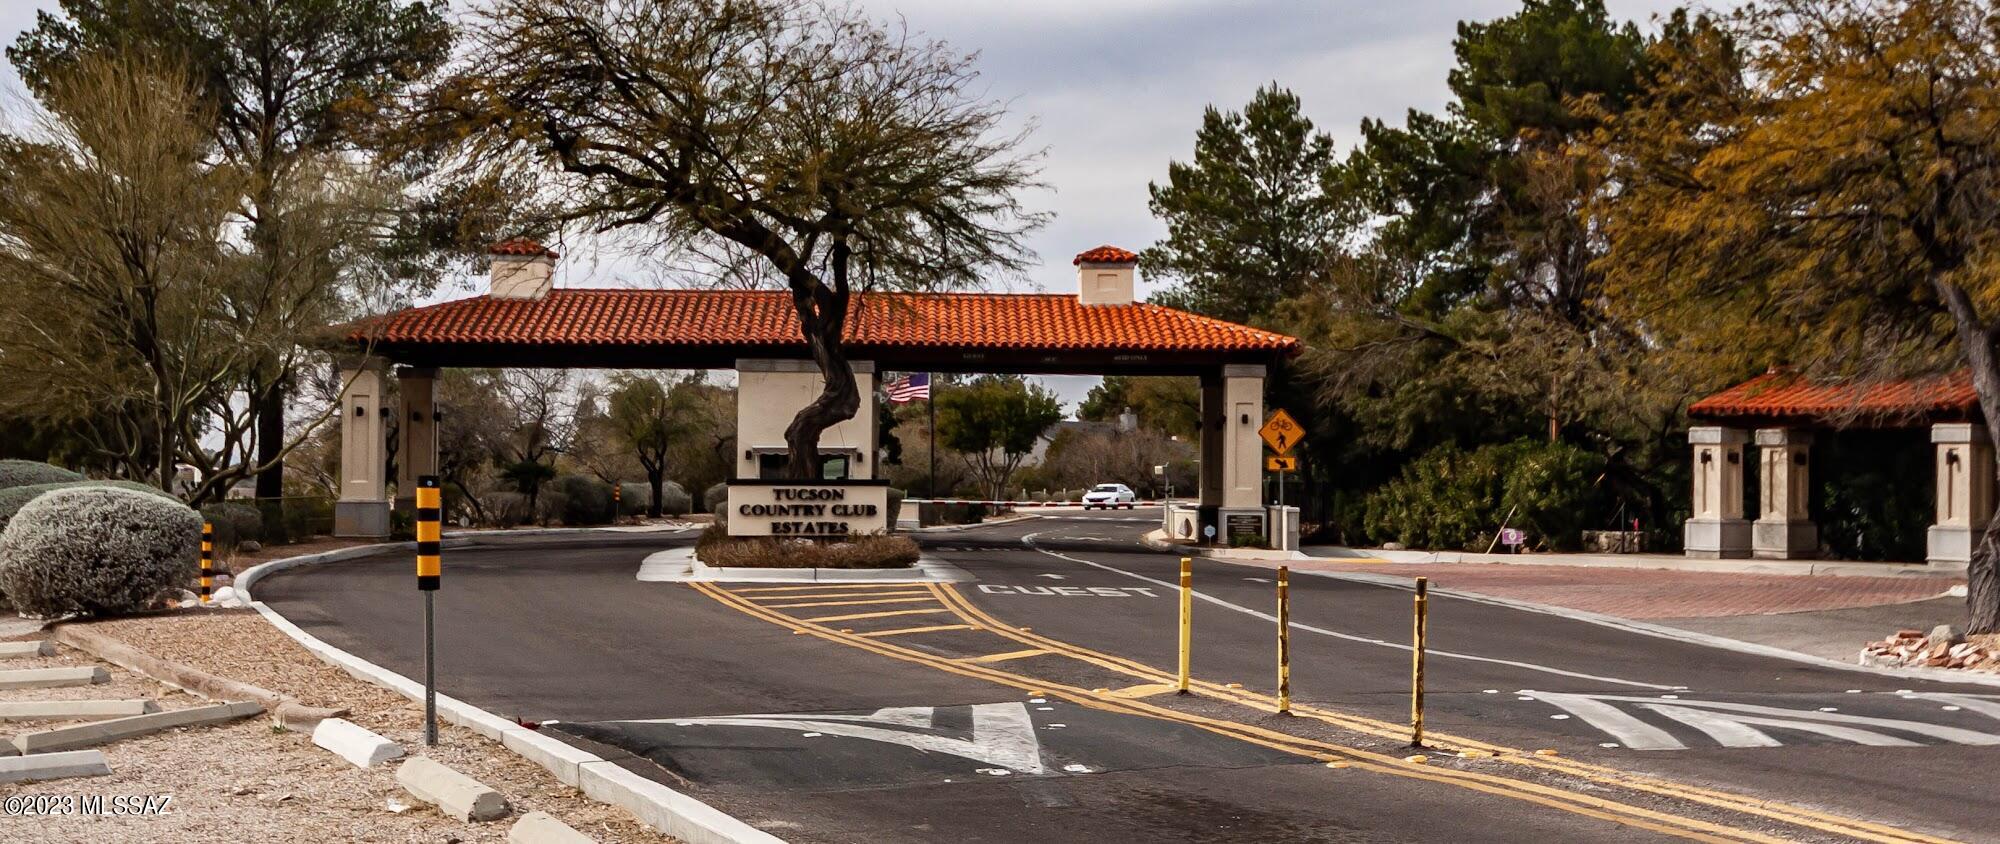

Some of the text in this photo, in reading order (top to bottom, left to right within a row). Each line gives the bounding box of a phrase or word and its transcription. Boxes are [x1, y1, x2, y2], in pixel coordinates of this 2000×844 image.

[773, 488, 844, 501] TUCSON
[739, 504, 877, 516] COUNTRY CLUB
[771, 521, 849, 534] ESTATES
